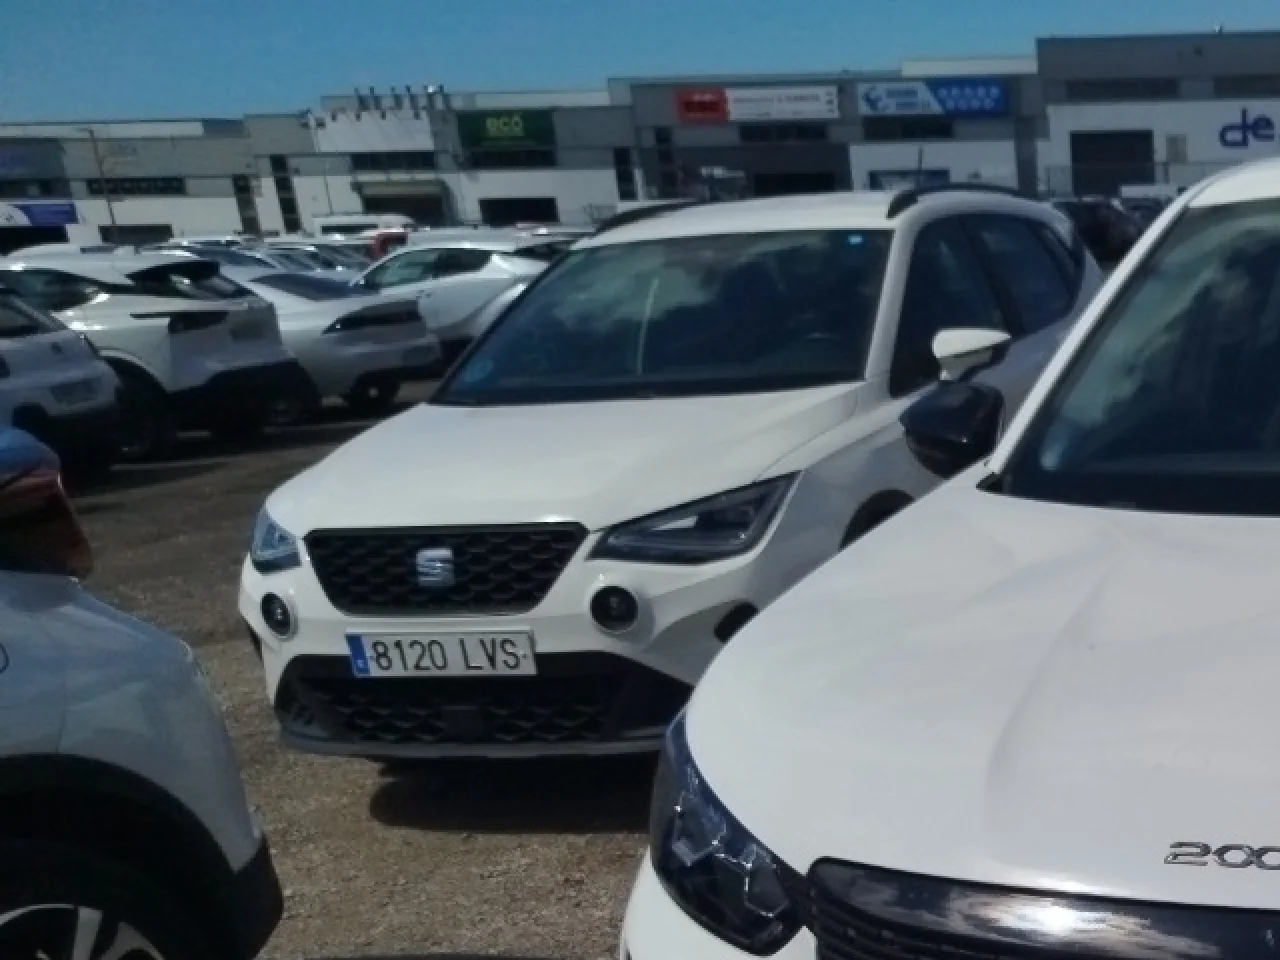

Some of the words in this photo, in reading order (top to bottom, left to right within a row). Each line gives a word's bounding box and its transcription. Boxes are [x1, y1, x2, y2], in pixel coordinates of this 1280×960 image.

[1218, 107, 1275, 147] de
[371, 639, 448, 671] 8120
[459, 638, 520, 671] LVS
